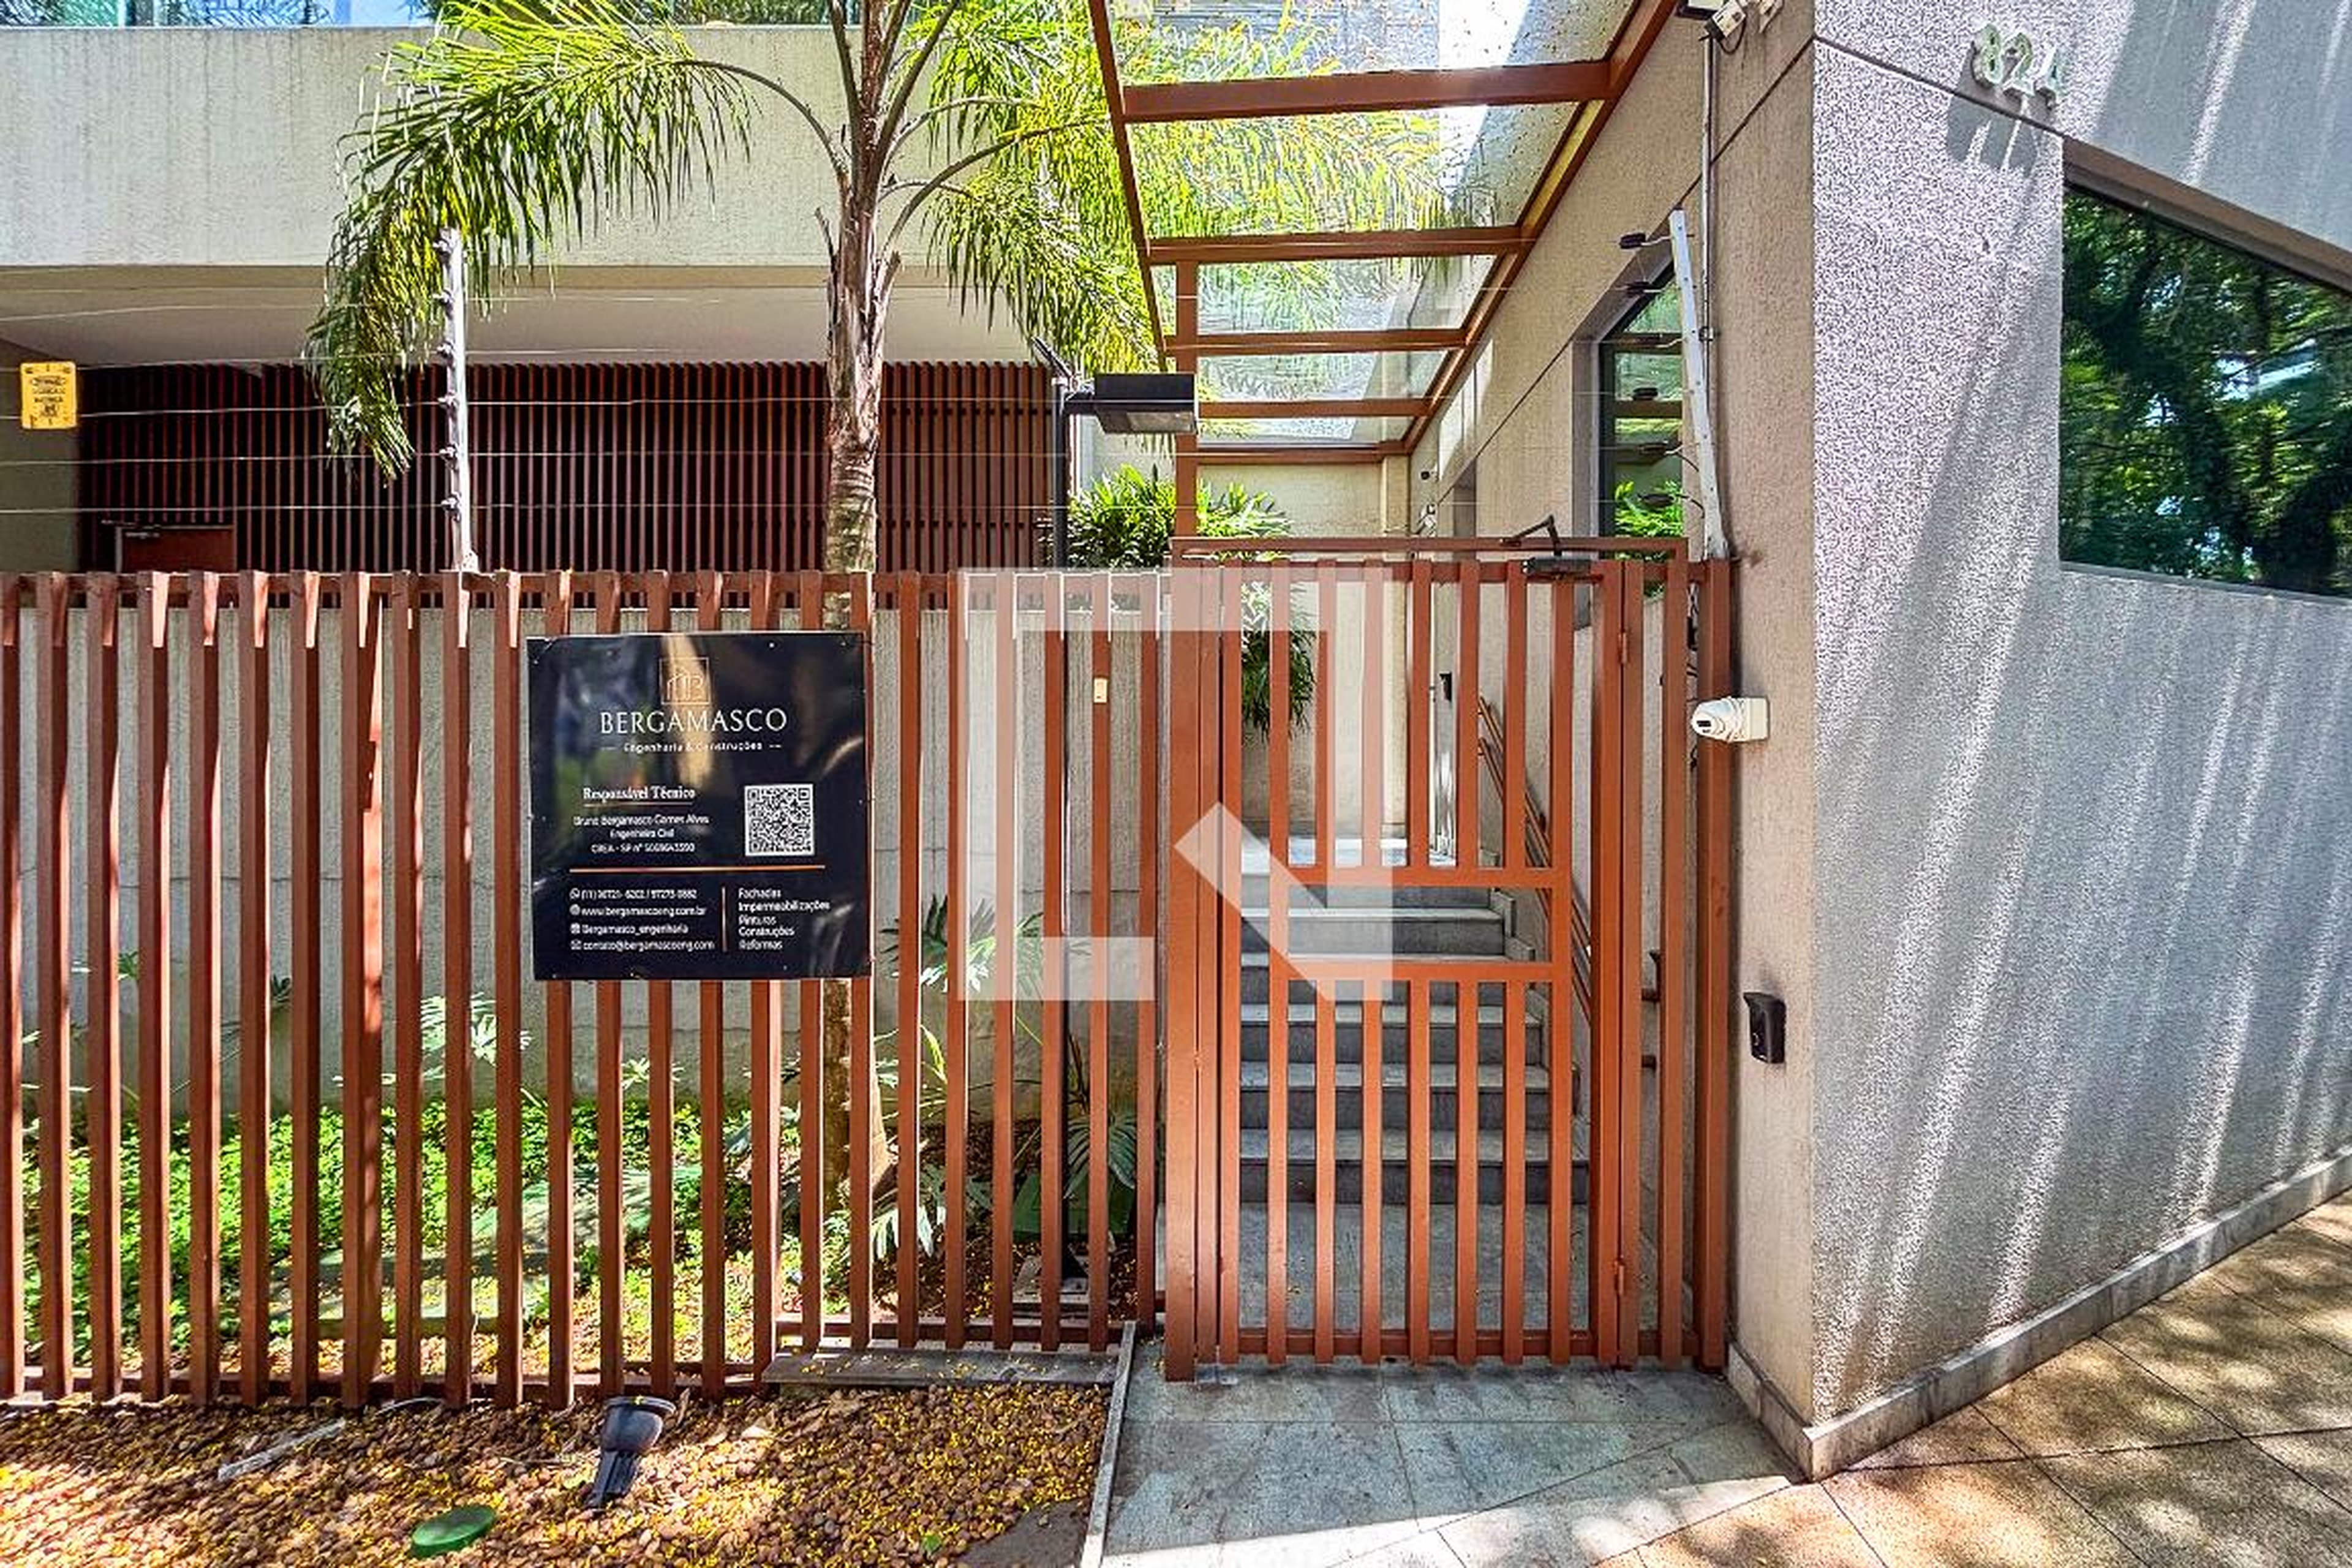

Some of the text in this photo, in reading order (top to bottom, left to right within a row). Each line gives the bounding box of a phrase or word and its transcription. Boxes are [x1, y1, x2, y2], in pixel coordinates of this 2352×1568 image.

[600, 708, 787, 734] BERGAMASCO
[624, 742, 682, 754] Engenharia
[583, 785, 696, 803] Responsável Técnico
